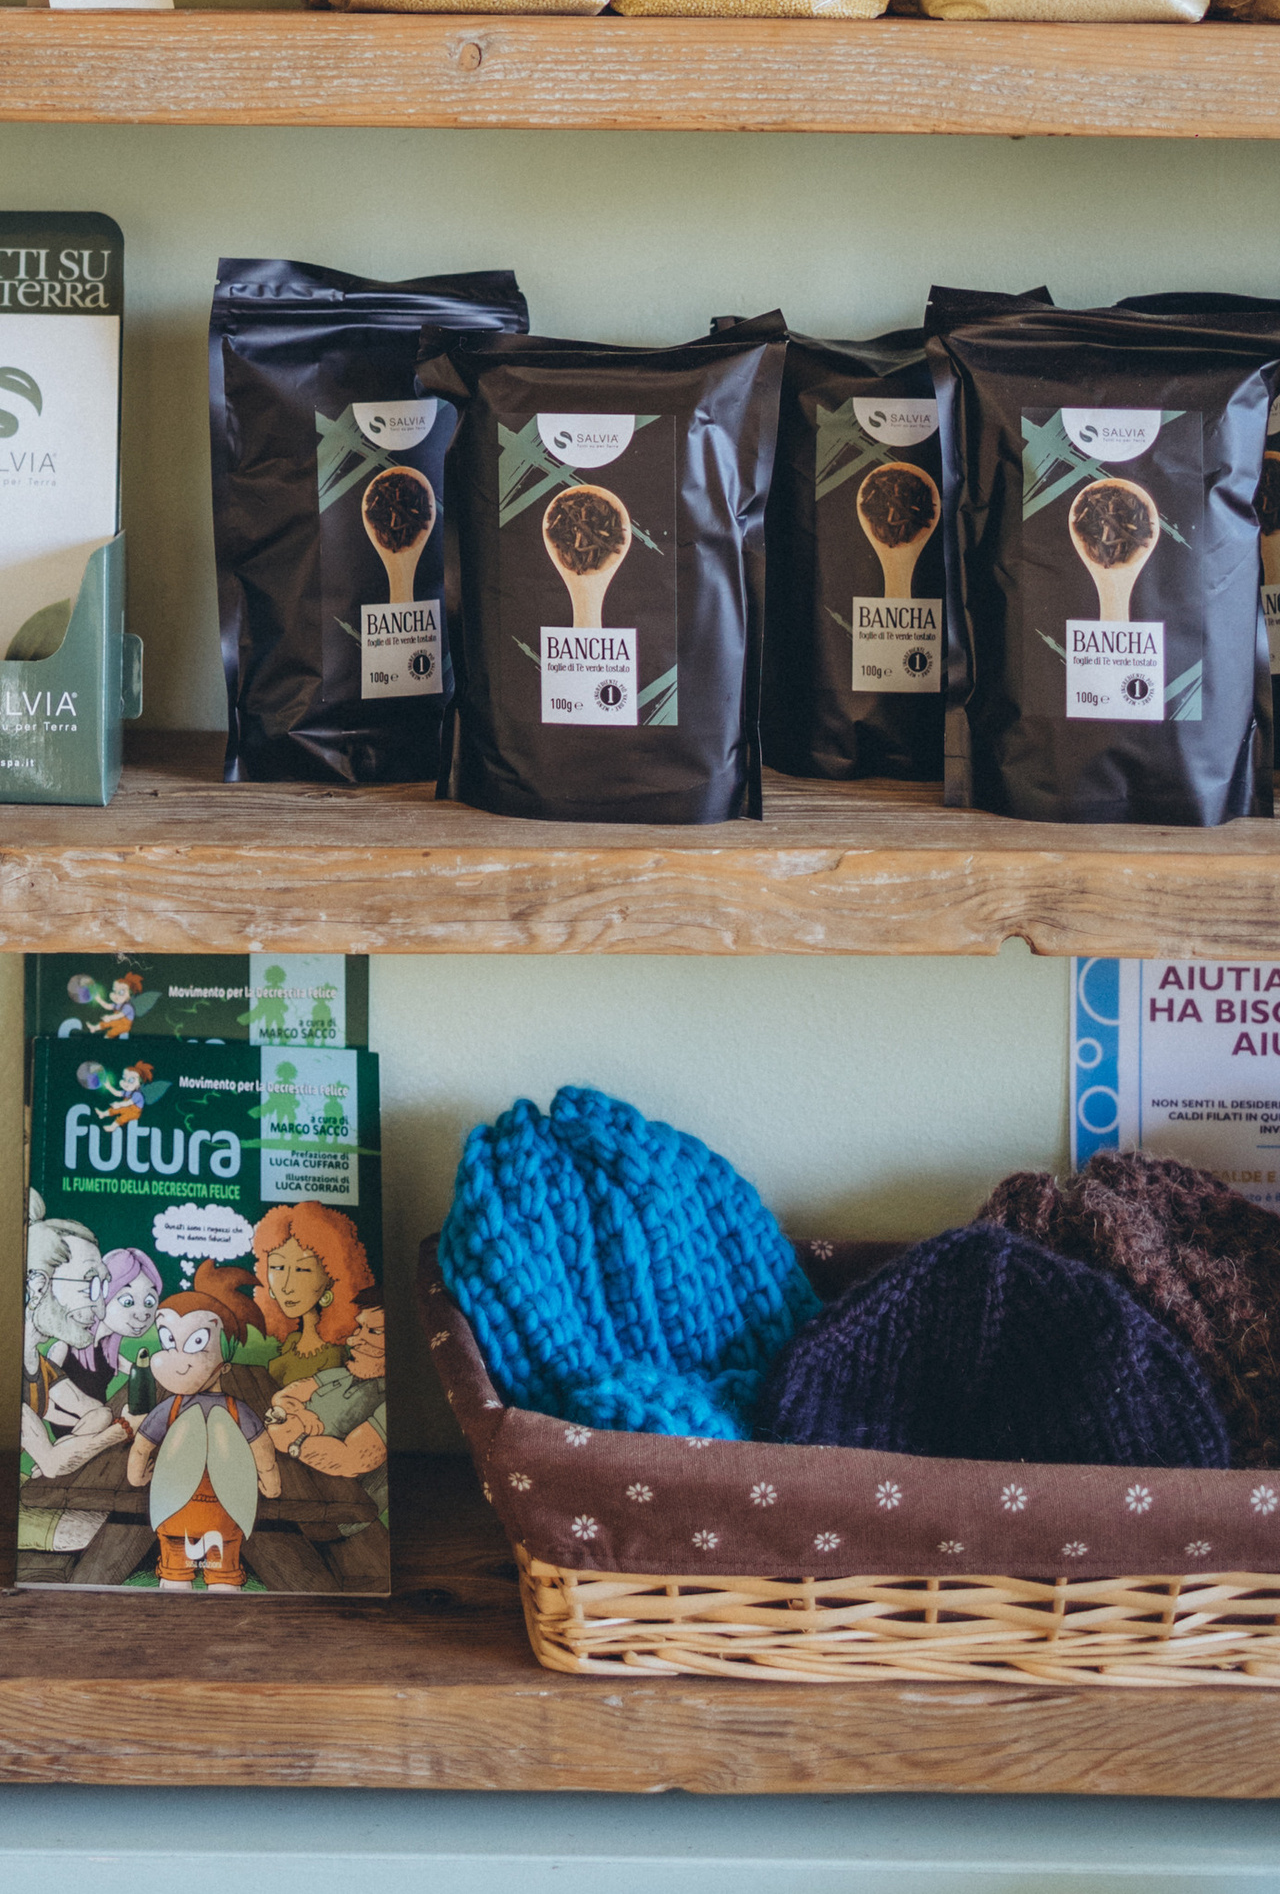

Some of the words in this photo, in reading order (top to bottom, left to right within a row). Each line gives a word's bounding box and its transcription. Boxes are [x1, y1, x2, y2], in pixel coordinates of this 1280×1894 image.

[58, 249, 111, 281] SU
[389, 416, 426, 427] SALVIA
[890, 414, 931, 423] SALVIA
[576, 433, 618, 443] SALVIA
[1102, 428, 1146, 437] SALVIA
[3, 477, 21, 487] per
[28, 477, 57, 487] Terra
[367, 609, 437, 635] BANCHA
[859, 606, 936, 629] BANCHA
[367, 638, 384, 648] foglie
[385, 636, 391, 646] di
[400, 635, 417, 645] verde
[859, 631, 877, 641] foglie
[878, 631, 885, 640] di
[895, 632, 913, 641] verde
[914, 632, 936, 641] tostato
[1073, 630, 1157, 654] BANCHA
[547, 636, 630, 660] BANCHA
[547, 663, 566, 673] foglie
[567, 663, 575, 672] di
[576, 663, 584, 672] Tè
[585, 664, 604, 673] verde
[605, 665, 630, 673] tostato
[1073, 656, 1093, 666] foglie
[1094, 656, 1101, 665] di
[1102, 656, 1111, 665] Tè
[1112, 657, 1132, 666] verde
[1132, 658, 1158, 667] tostato
[370, 672, 389, 684] 100g
[861, 665, 882, 679] 100g
[551, 698, 572, 712] 100g
[1076, 691, 1098, 706] 100g
[15, 723, 37, 733] per
[43, 721, 78, 732] Terra
[168, 985, 225, 998] Movimento
[226, 987, 243, 1002] per
[245, 986, 255, 998] la
[257, 987, 306, 999] Decrescita
[308, 986, 337, 999] Felice
[1150, 997, 1203, 1023] HA
[306, 1019, 325, 1027] cura
[326, 1018, 337, 1028] di
[259, 1027, 298, 1039] MARCO
[301, 1028, 337, 1040] SACCO
[179, 1076, 236, 1091] Movimento
[237, 1080, 254, 1093] per
[255, 1080, 265, 1092] la
[267, 1082, 318, 1096] Decrescita
[320, 1083, 349, 1097] Felice
[1151, 1099, 1179, 1107] NON
[1181, 1099, 1215, 1108] SENTI
[1218, 1100, 1228, 1109] IL
[310, 1116, 316, 1124] a
[317, 1116, 337, 1125] cura
[339, 1115, 349, 1125] di
[1168, 1111, 1203, 1121] CALDI
[1206, 1112, 1242, 1121] FILATI
[1245, 1113, 1258, 1122] IN
[270, 1122, 310, 1135] MARCO
[313, 1124, 349, 1137] SACCO
[64, 1103, 241, 1178] futura
[291, 1150, 338, 1160] Prefazione
[340, 1152, 349, 1161] di
[269, 1157, 300, 1167] LUCIA
[302, 1159, 349, 1170] CUFFARO
[285, 1173, 339, 1184] Illustrazioni
[340, 1176, 349, 1185] di
[62, 1177, 71, 1191] IL
[72, 1178, 119, 1193] FUMETTO
[120, 1179, 150, 1195] DELLA
[151, 1181, 208, 1198] DECRESCITA
[209, 1184, 241, 1200] FELICE
[275, 1181, 302, 1191] LUCA
[304, 1183, 350, 1194] CORRADI
